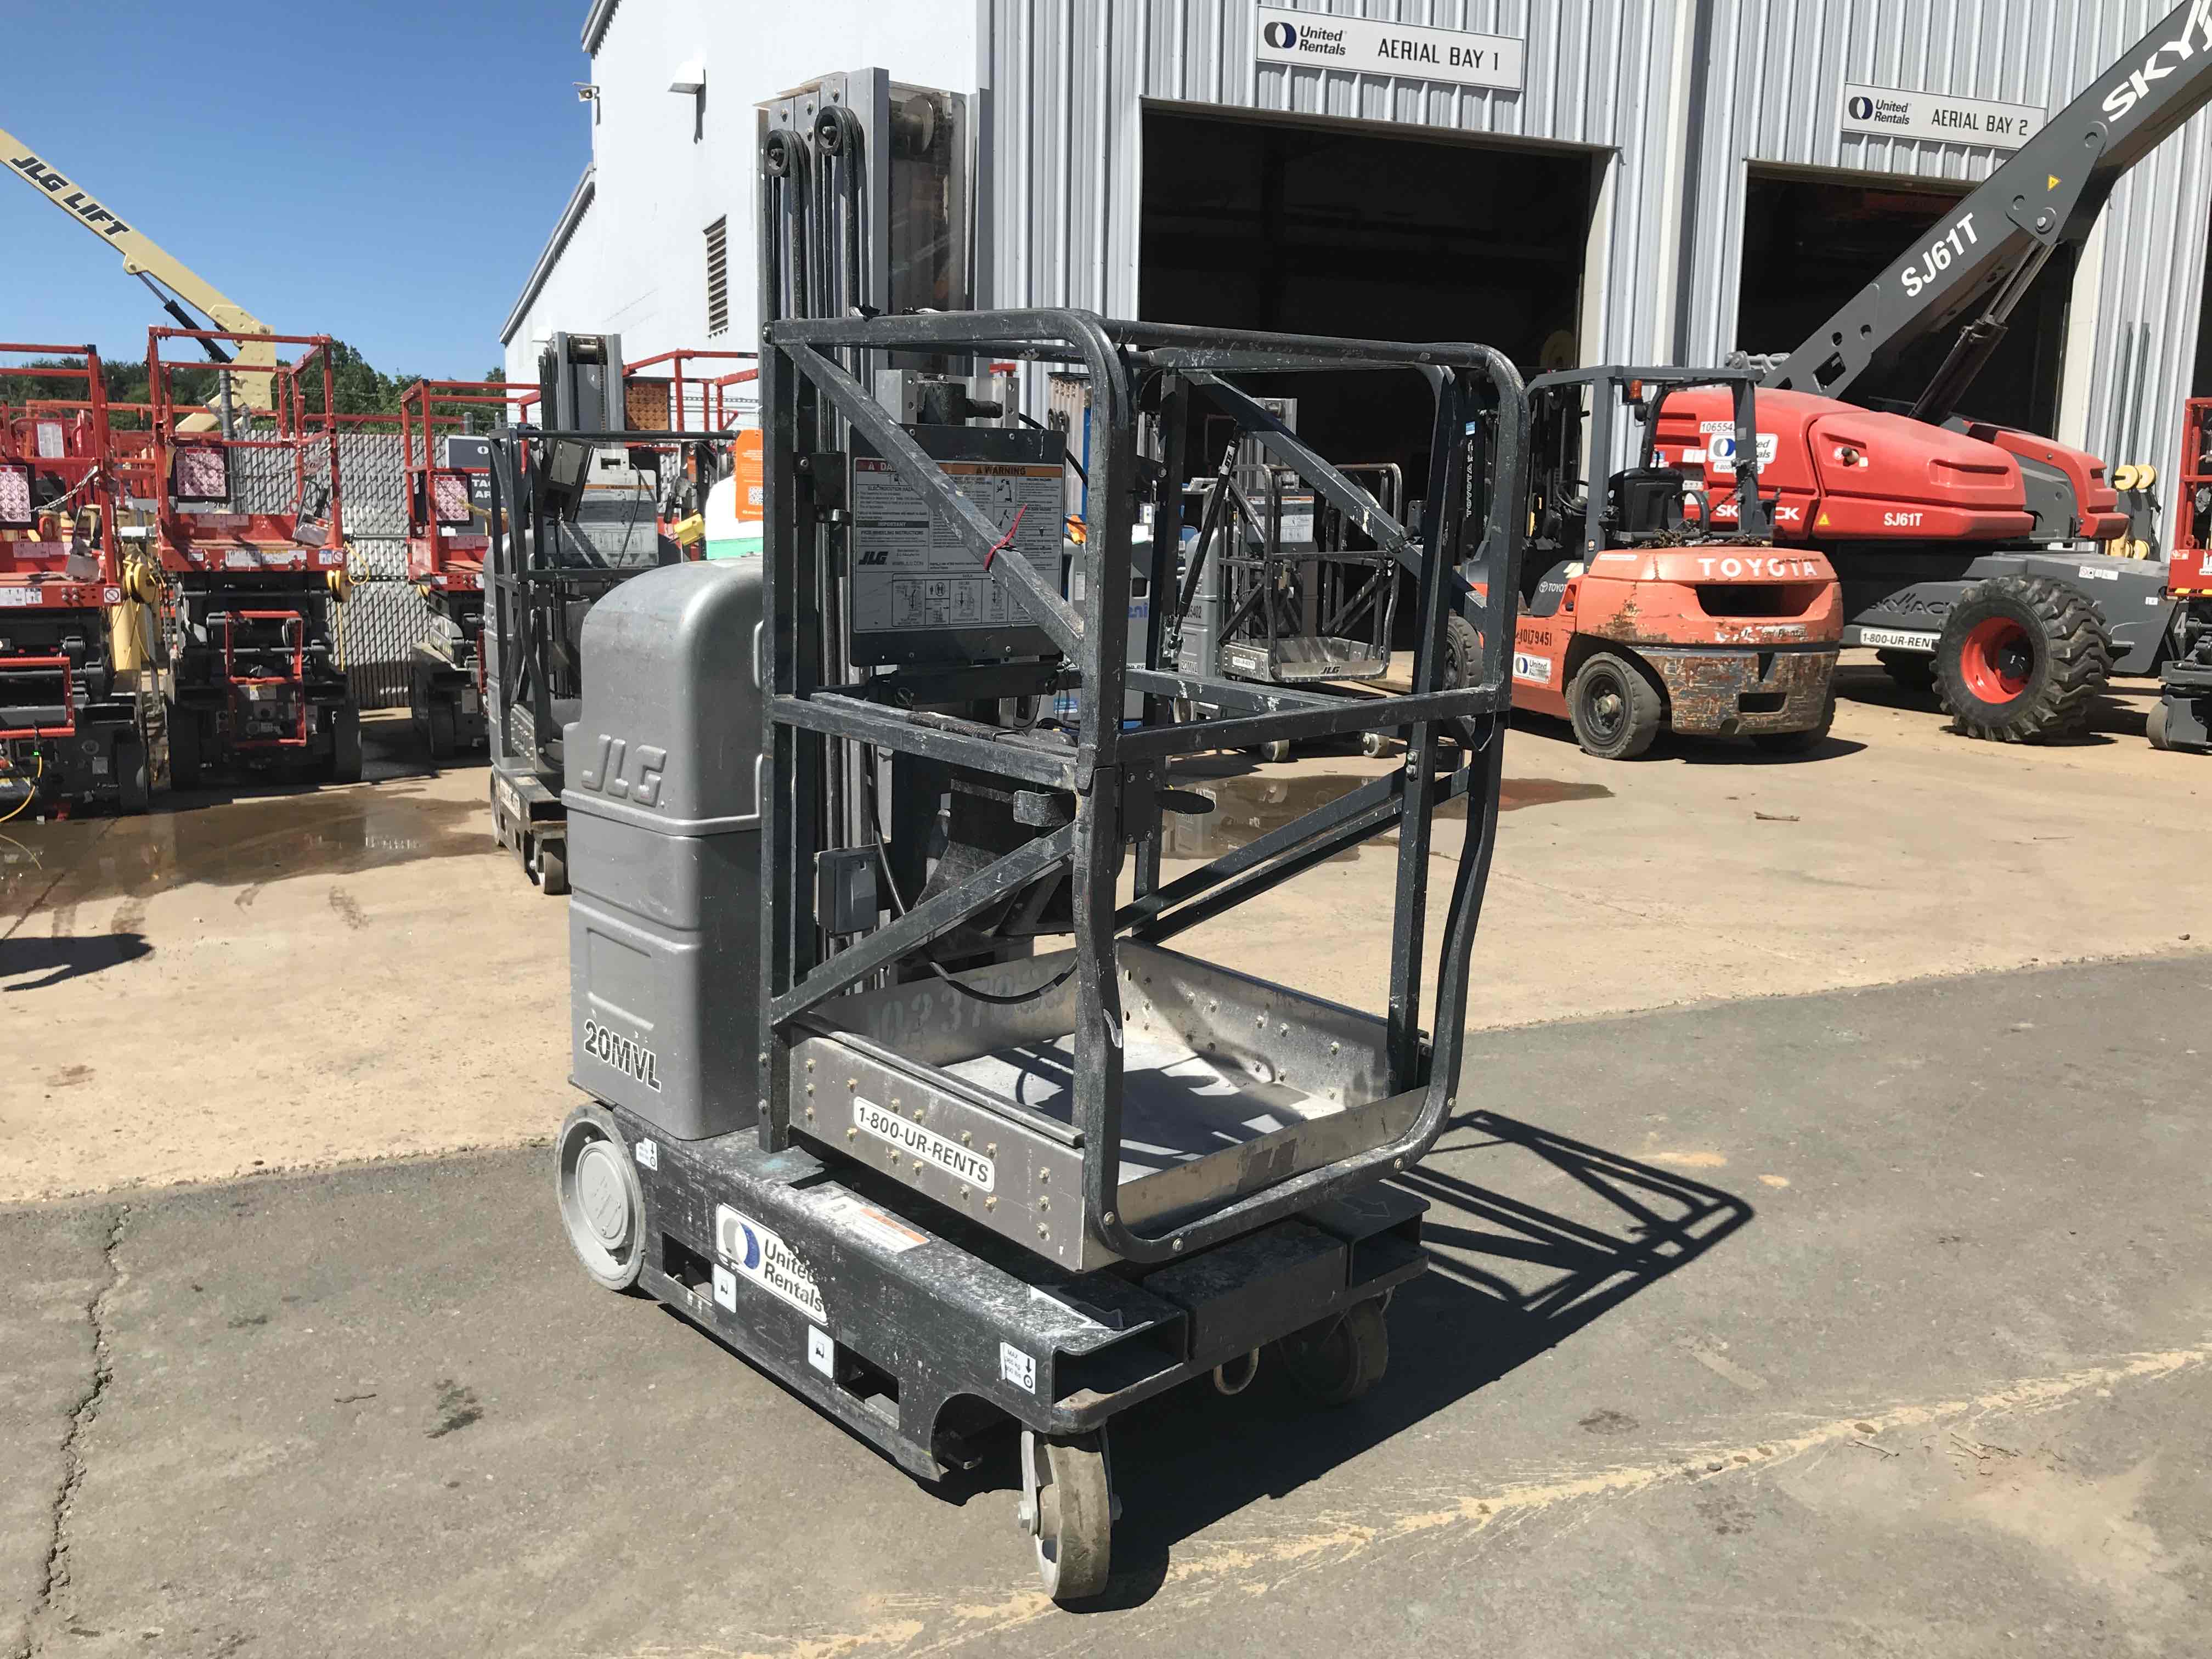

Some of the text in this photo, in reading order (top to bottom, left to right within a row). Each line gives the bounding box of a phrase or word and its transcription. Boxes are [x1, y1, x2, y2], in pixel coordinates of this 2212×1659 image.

[1300, 25, 1343, 42] United
[1299, 38, 1346, 56] Rentals
[1378, 38, 1499, 71] AERIAL BAY 1
[1875, 99, 1908, 112] United
[1874, 111, 1910, 125] Rentals
[1931, 109, 2028, 136] AERIAL BAY 2
[10, 156, 131, 236] JLG LIFT
[1900, 212, 1979, 297] SJ61T
[1702, 422, 1735, 432] 106554
[985, 466, 1026, 475] WARNING
[1883, 512, 1923, 527] SJ61T
[859, 551, 888, 565] JLG
[1697, 557, 1818, 577] TOYOTA
[1548, 583, 1567, 592] TOYOT
[1863, 633, 1931, 648] 1-800-UR-REN
[1321, 666, 1341, 674] JLG
[582, 733, 667, 807] JLG
[583, 1019, 662, 1092] 20MVL
[859, 1107, 989, 1183] 1-800-UR-RENTS
[764, 1262, 825, 1313] Rentals
